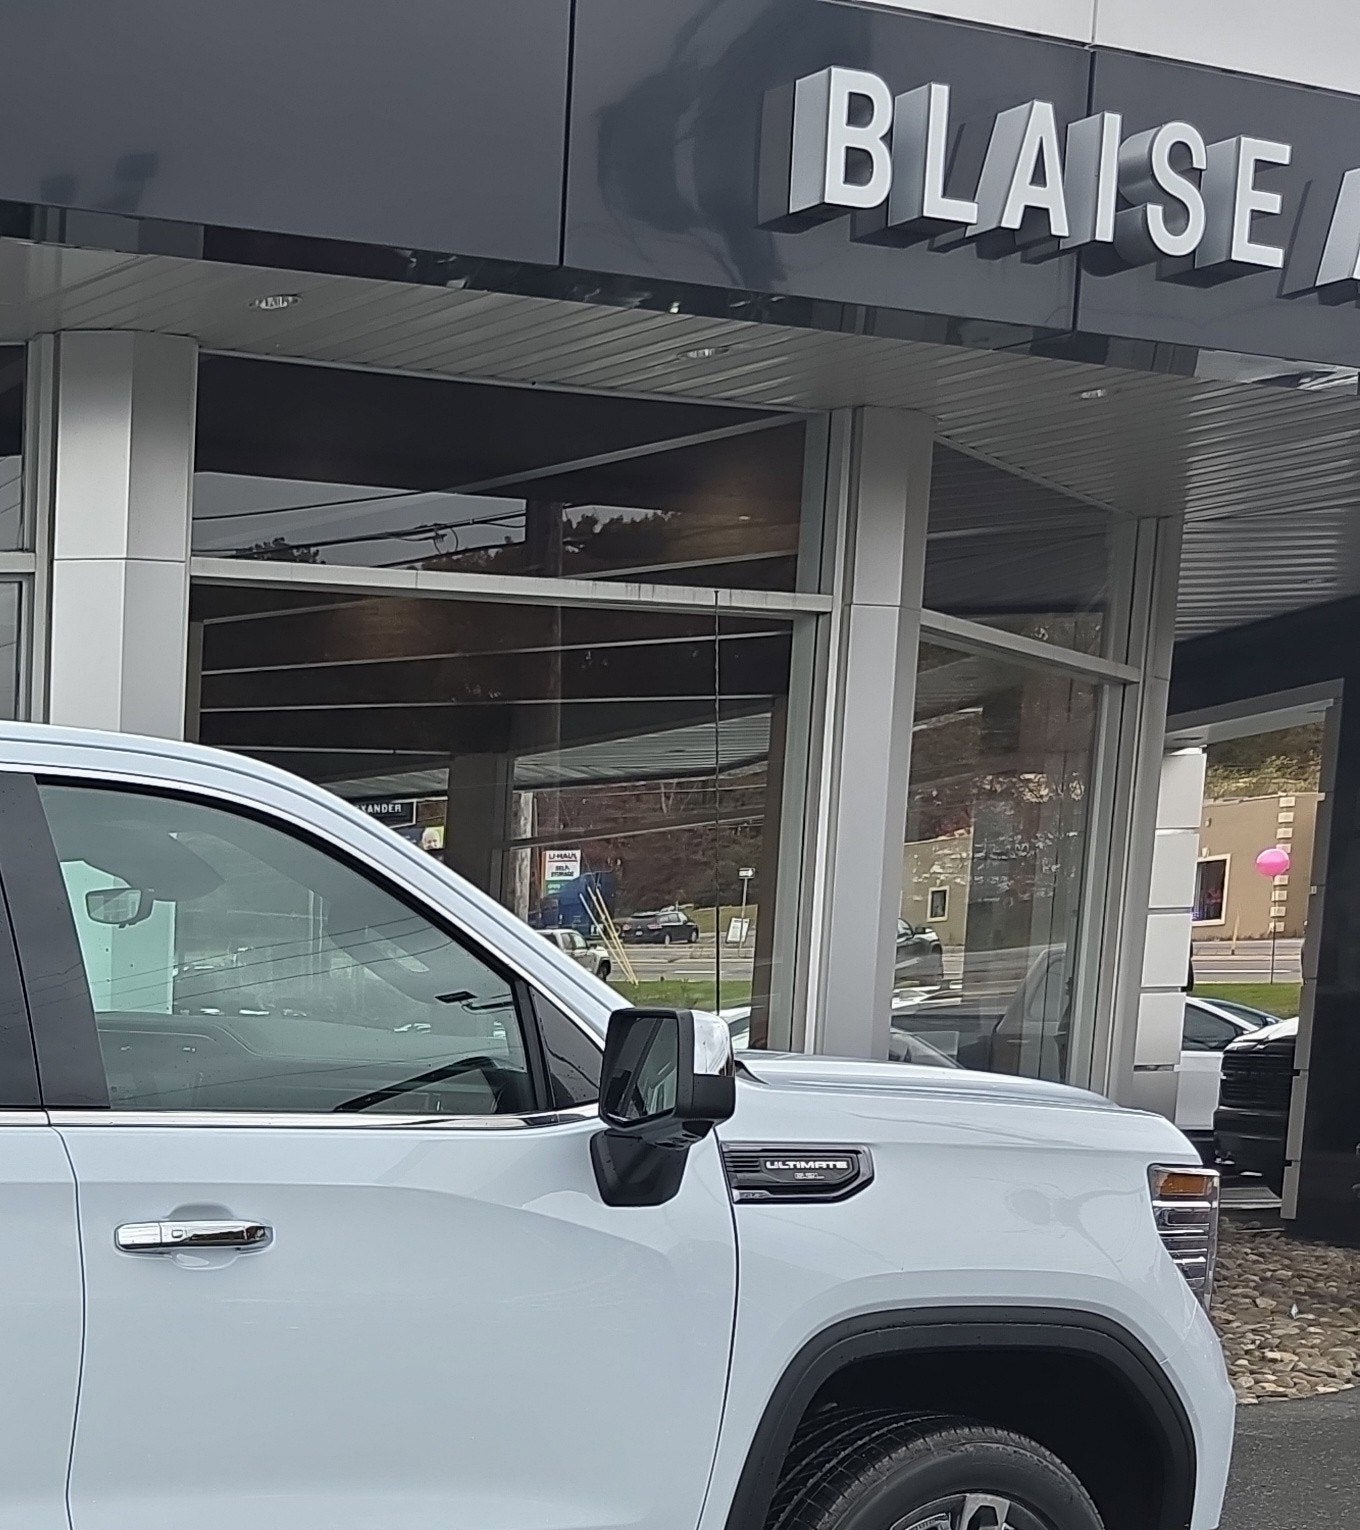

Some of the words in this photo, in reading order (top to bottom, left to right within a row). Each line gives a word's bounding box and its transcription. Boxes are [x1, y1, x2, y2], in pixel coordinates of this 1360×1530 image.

[789, 65, 1293, 269] BLAISE
[356, 803, 402, 814] XANDER
[765, 1160, 848, 1170] ULTIMATE
